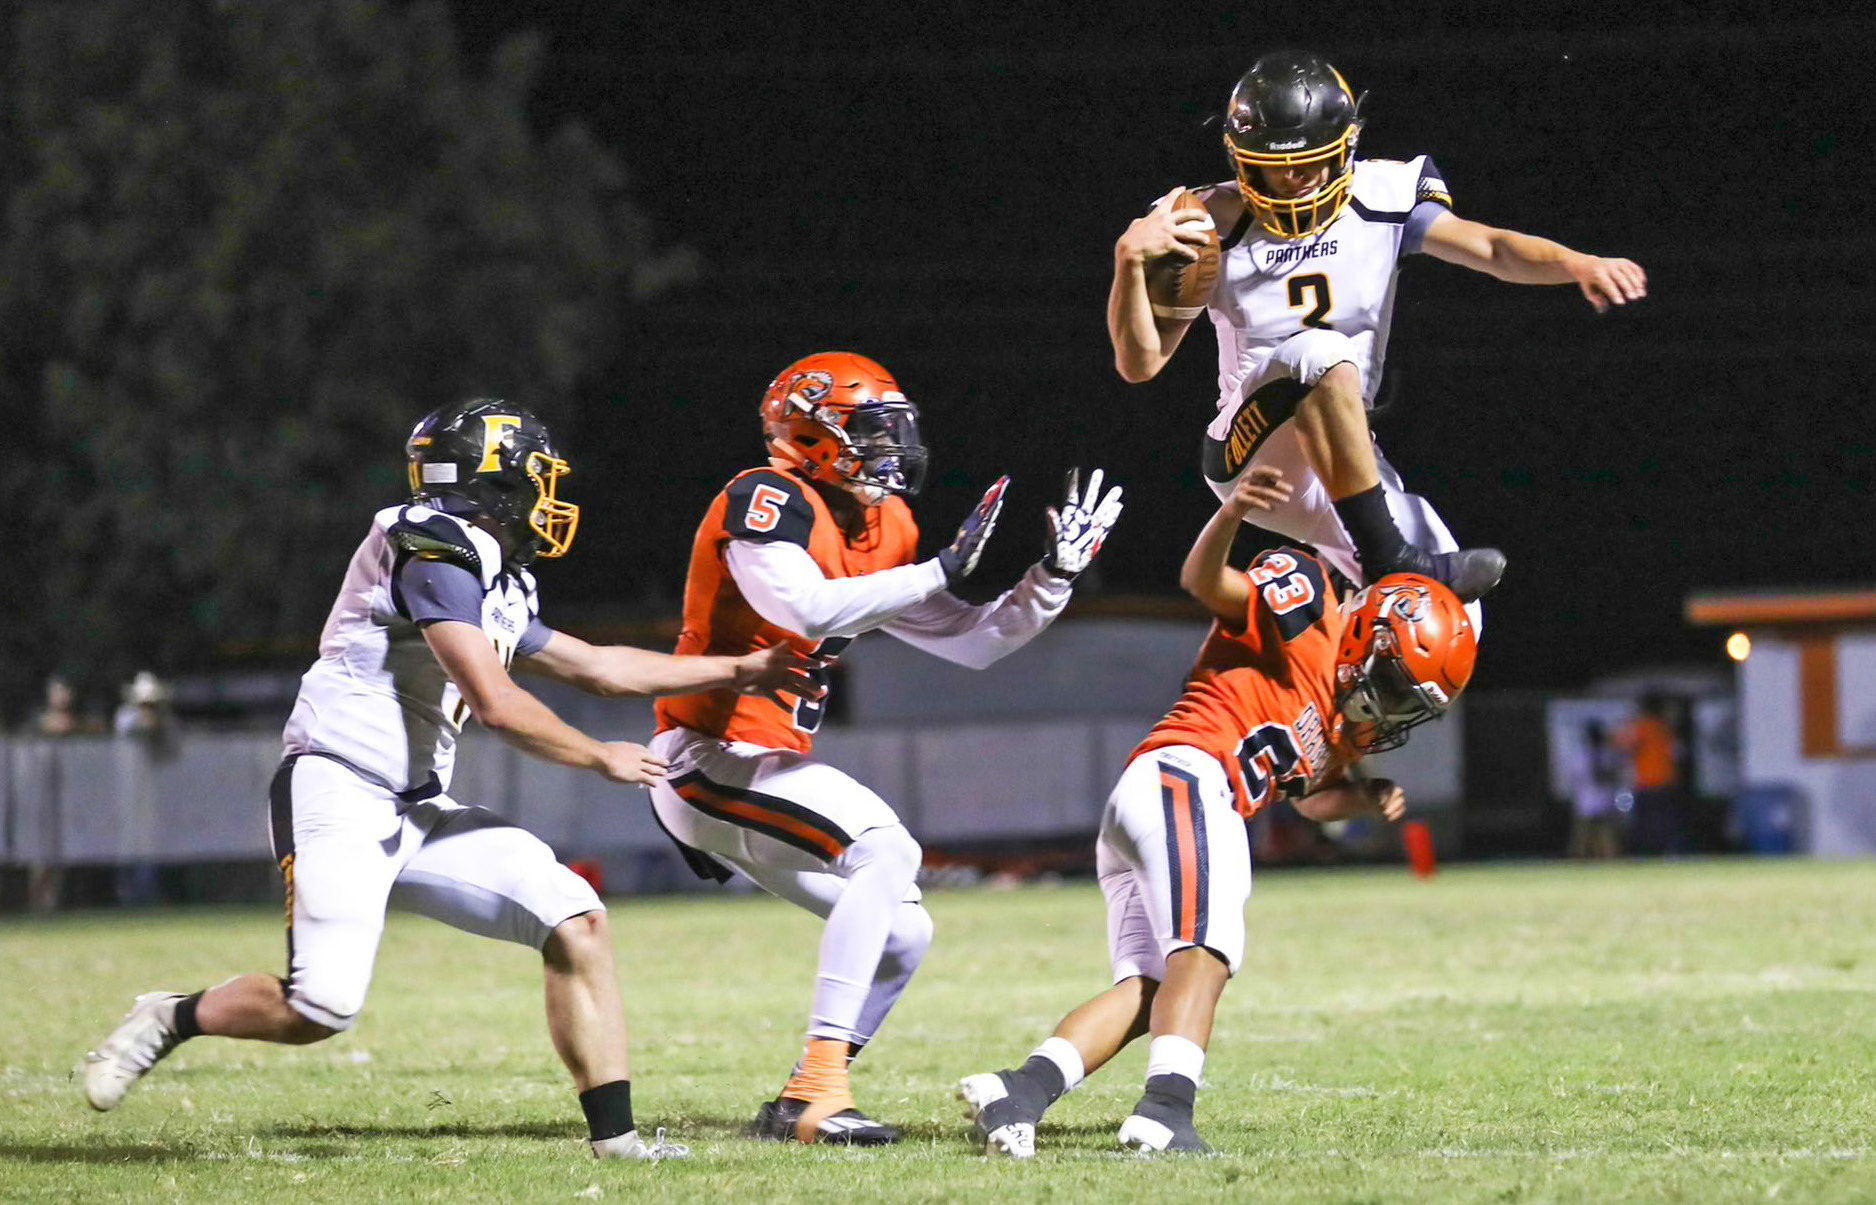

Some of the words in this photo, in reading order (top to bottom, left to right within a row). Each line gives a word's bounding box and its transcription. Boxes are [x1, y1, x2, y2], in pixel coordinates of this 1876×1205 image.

[1266, 240, 1338, 264] PANTHERS
[1287, 272, 1334, 331] 2
[475, 415, 522, 473] F
[744, 483, 790, 533] 5
[1248, 553, 1316, 615] 23
